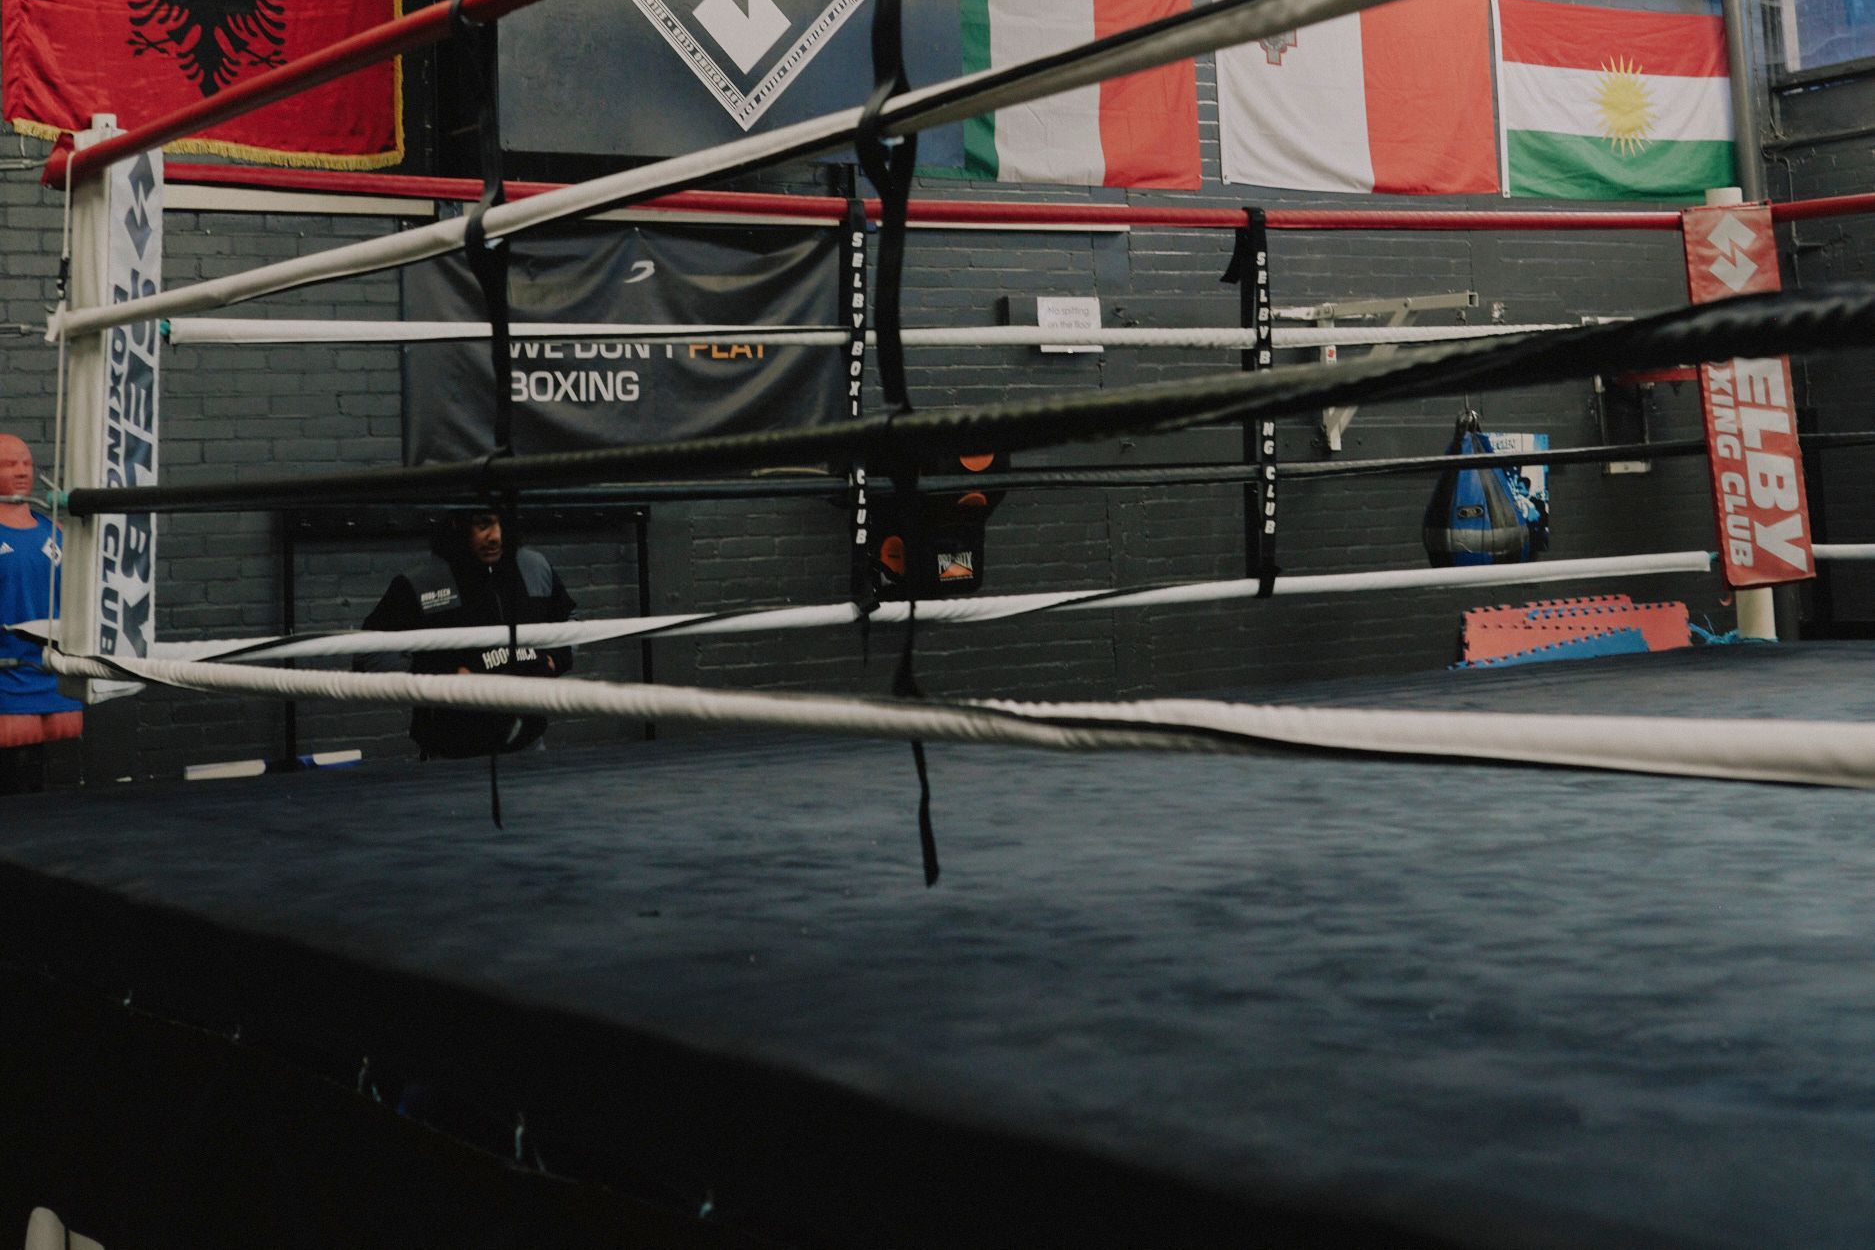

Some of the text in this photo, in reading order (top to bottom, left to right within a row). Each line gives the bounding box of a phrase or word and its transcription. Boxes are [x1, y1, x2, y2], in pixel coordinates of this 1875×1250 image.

[851, 232, 864, 329] SELBY
[121, 268, 156, 659] SELBY
[511, 369, 640, 402] BOXING
[1256, 251, 1269, 340] SELBY
[1264, 466, 1276, 534] CLUB
[1708, 363, 1754, 567] XING CLUB
[1733, 356, 1808, 573] ELBY
[99, 522, 120, 656] CLUB
[856, 469, 867, 544] CLUB
